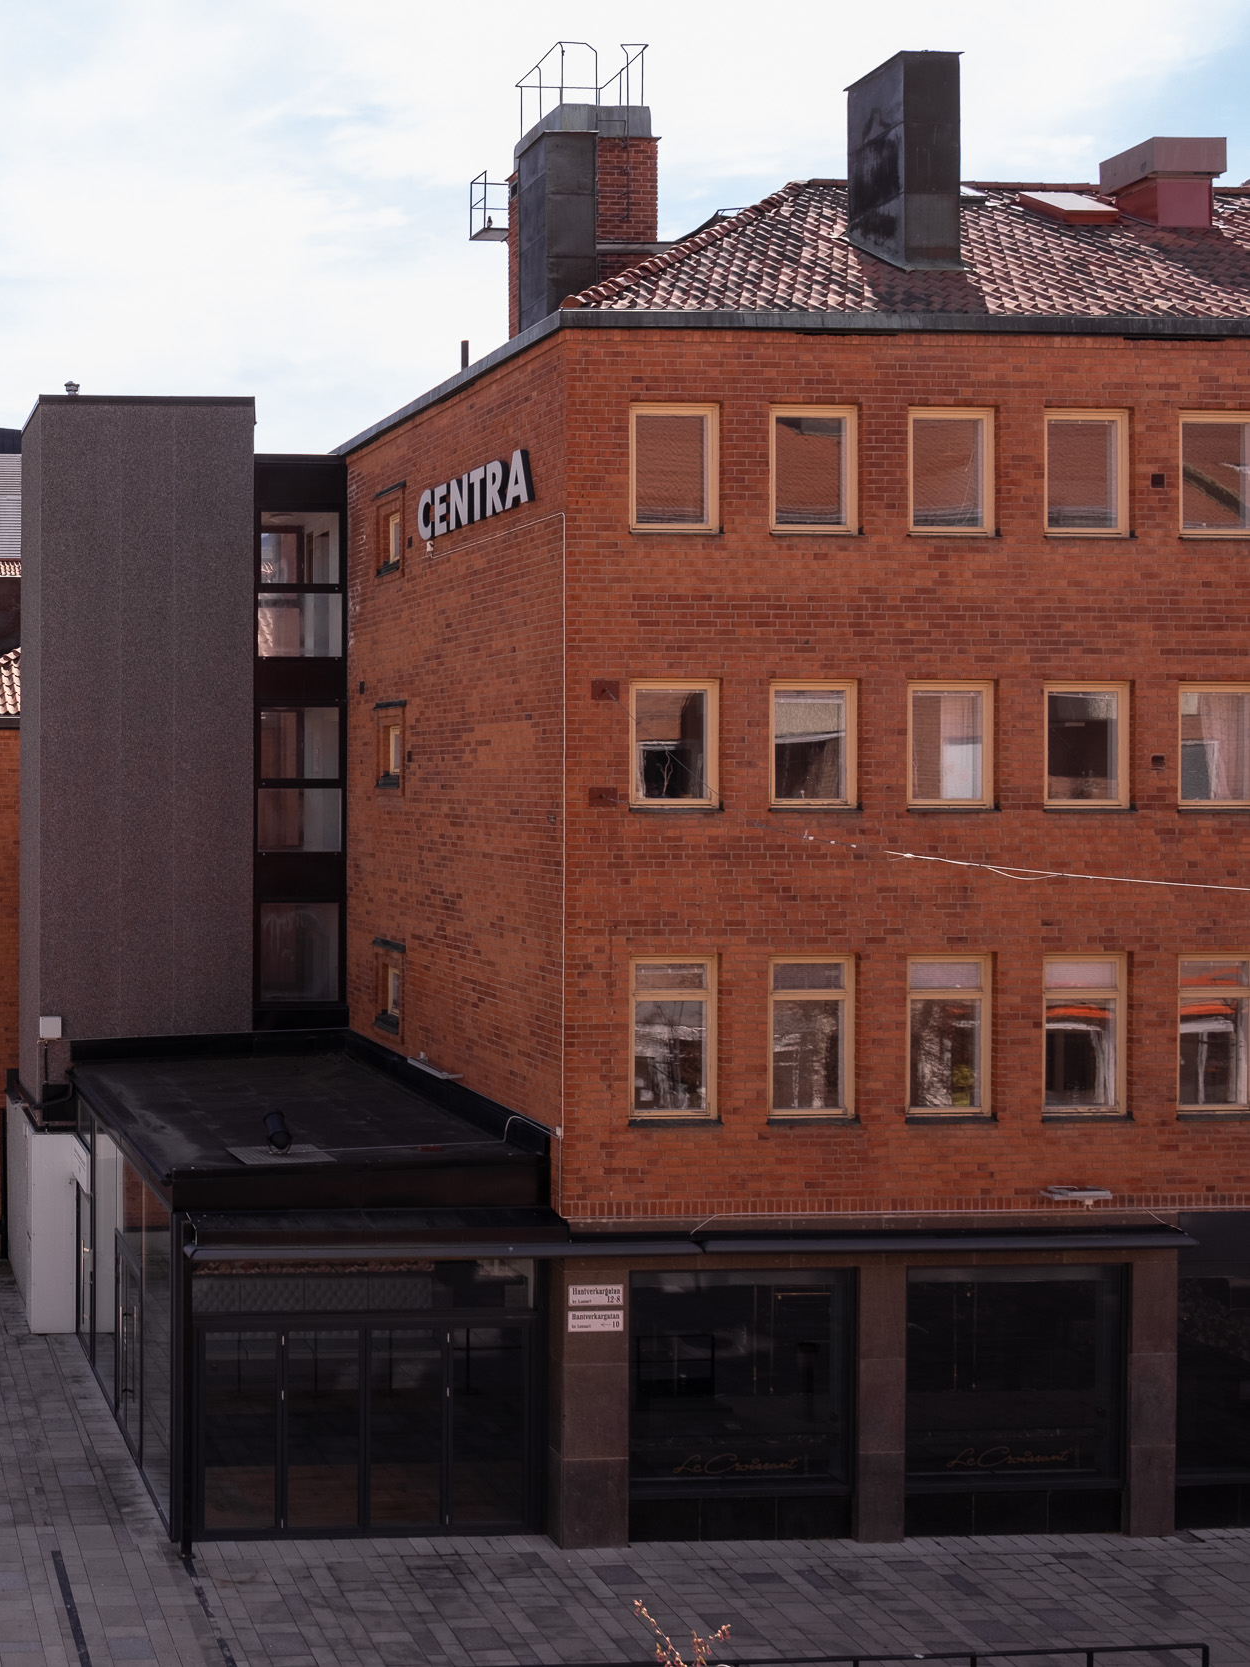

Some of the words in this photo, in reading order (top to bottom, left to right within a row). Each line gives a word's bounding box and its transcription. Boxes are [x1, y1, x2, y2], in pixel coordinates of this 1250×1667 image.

[418, 449, 532, 541] CENTRA
[572, 1287, 620, 1296] Hantverkargatan
[571, 1313, 620, 1321] Hantverkargatan
[673, 1454, 703, 1474] Le
[704, 1453, 798, 1474] Croissant
[946, 1447, 976, 1468] Le
[977, 1446, 1069, 1468] Croissant
